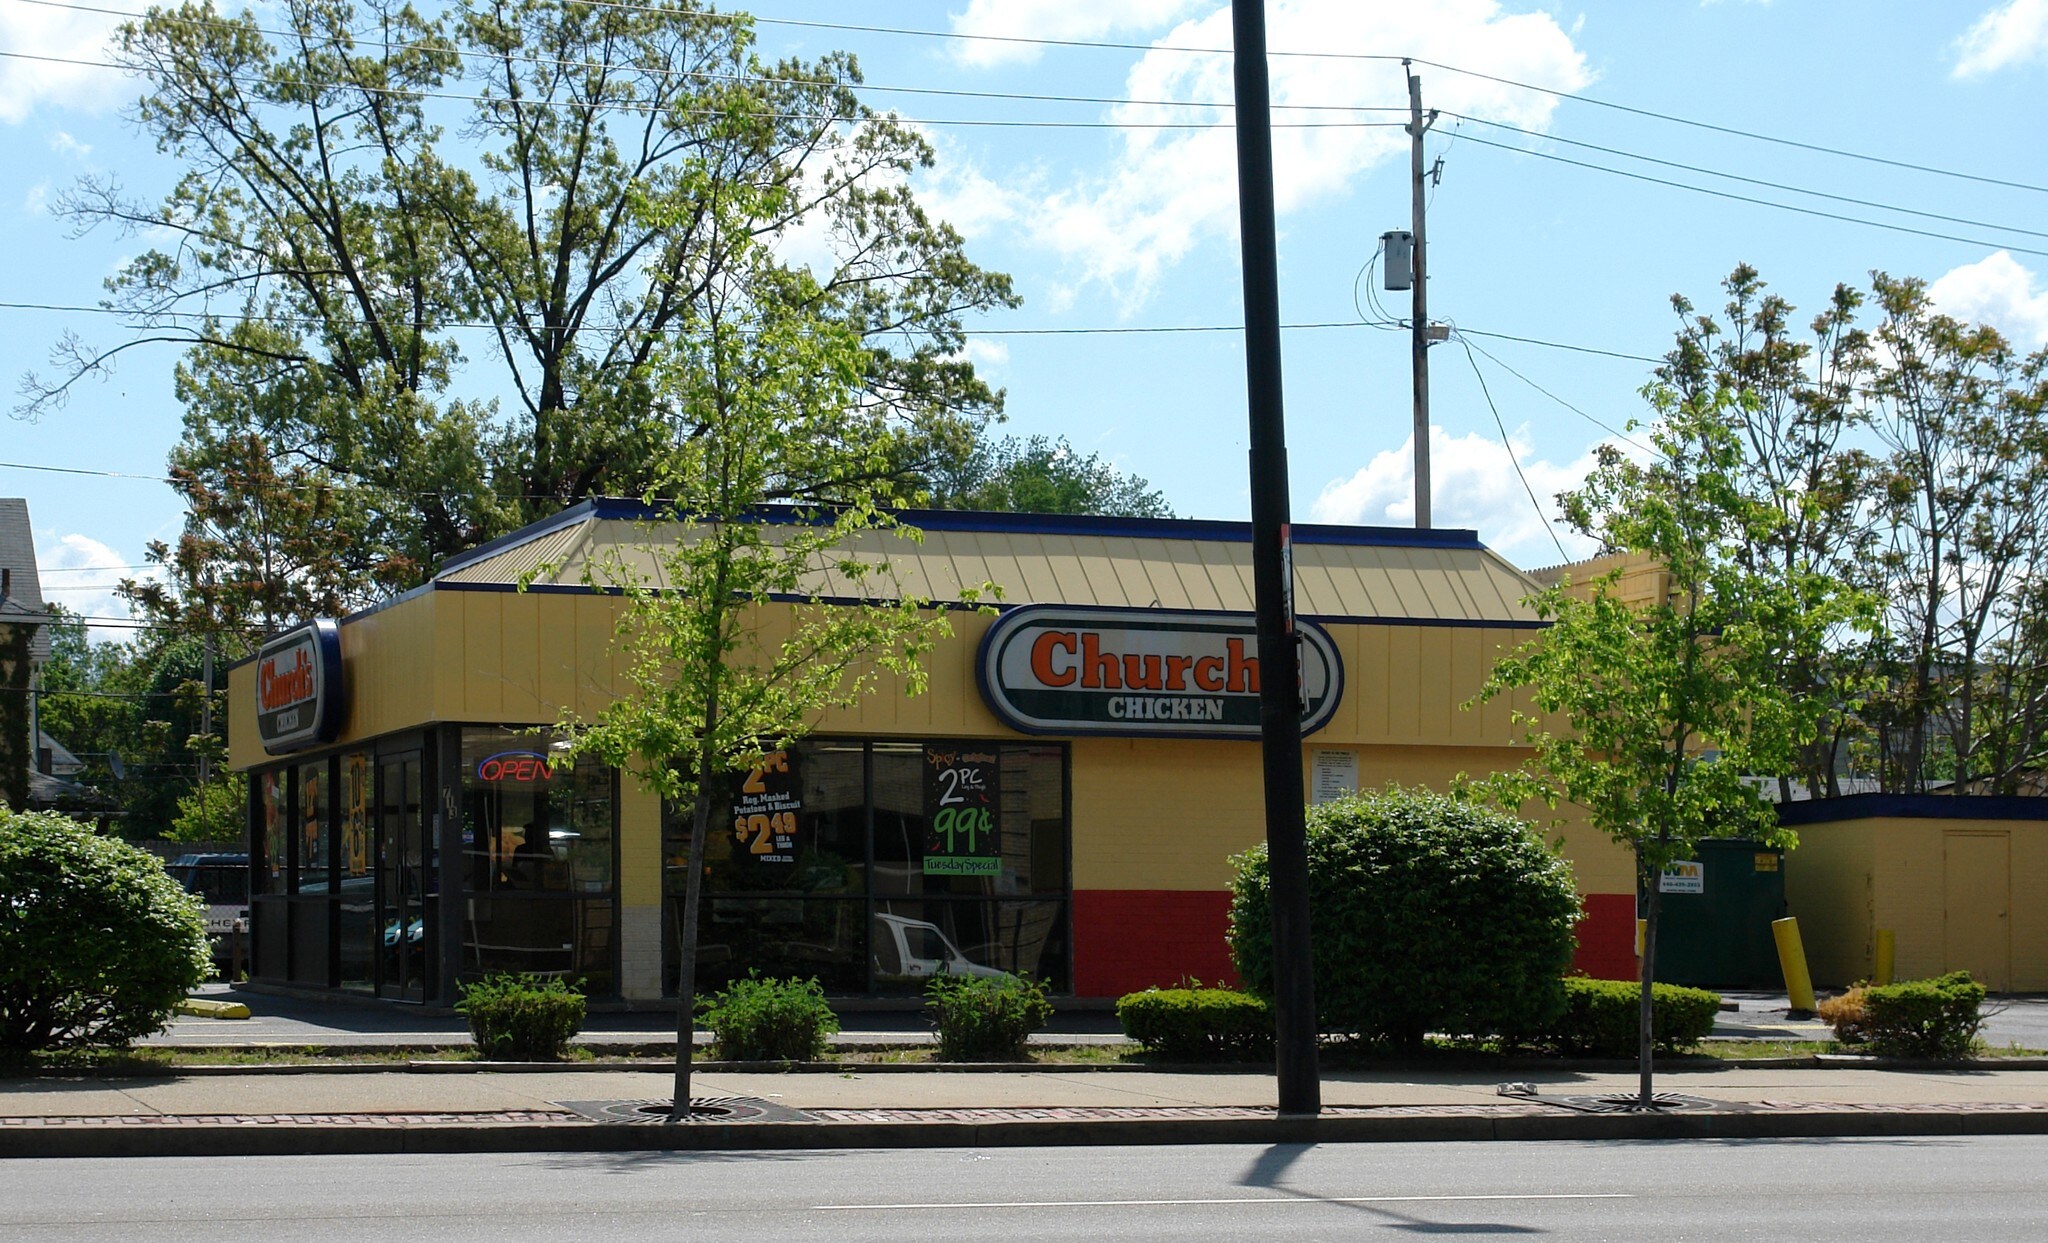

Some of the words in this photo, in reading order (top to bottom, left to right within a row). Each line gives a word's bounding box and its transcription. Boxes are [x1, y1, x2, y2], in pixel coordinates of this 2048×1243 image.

[1031, 630, 1301, 694] Church
[1107, 695, 1224, 721] CHICKEN
[481, 760, 554, 781] OPEN
[760, 791, 790, 803] Mashed
[733, 803, 767, 815] Potatoes
[774, 800, 801, 811] Biscuit
[926, 859, 965, 873] Tuesday
[964, 859, 999, 873] Special
